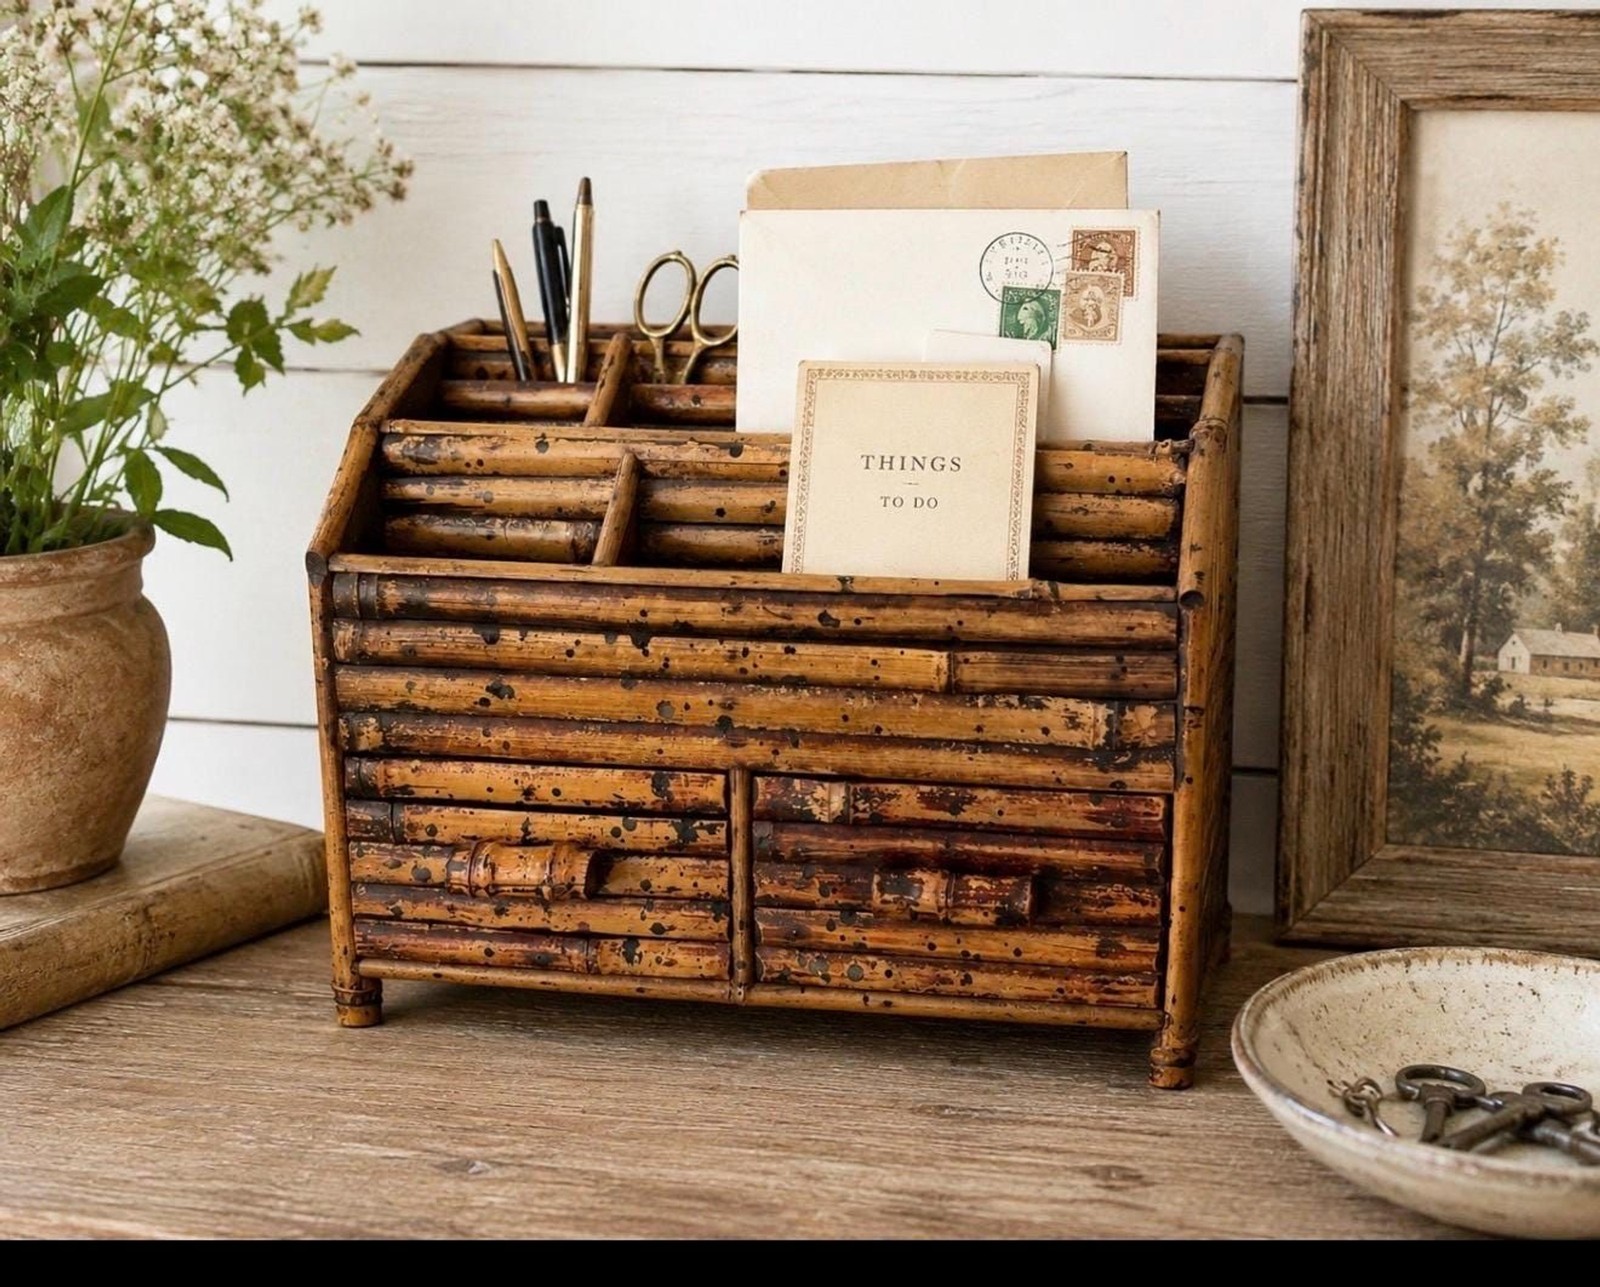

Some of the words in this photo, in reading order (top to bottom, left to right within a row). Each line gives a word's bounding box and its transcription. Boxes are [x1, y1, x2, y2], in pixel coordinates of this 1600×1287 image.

[861, 454, 962, 473] THINGS
[880, 495, 904, 508] TO
[913, 496, 938, 509] DO
